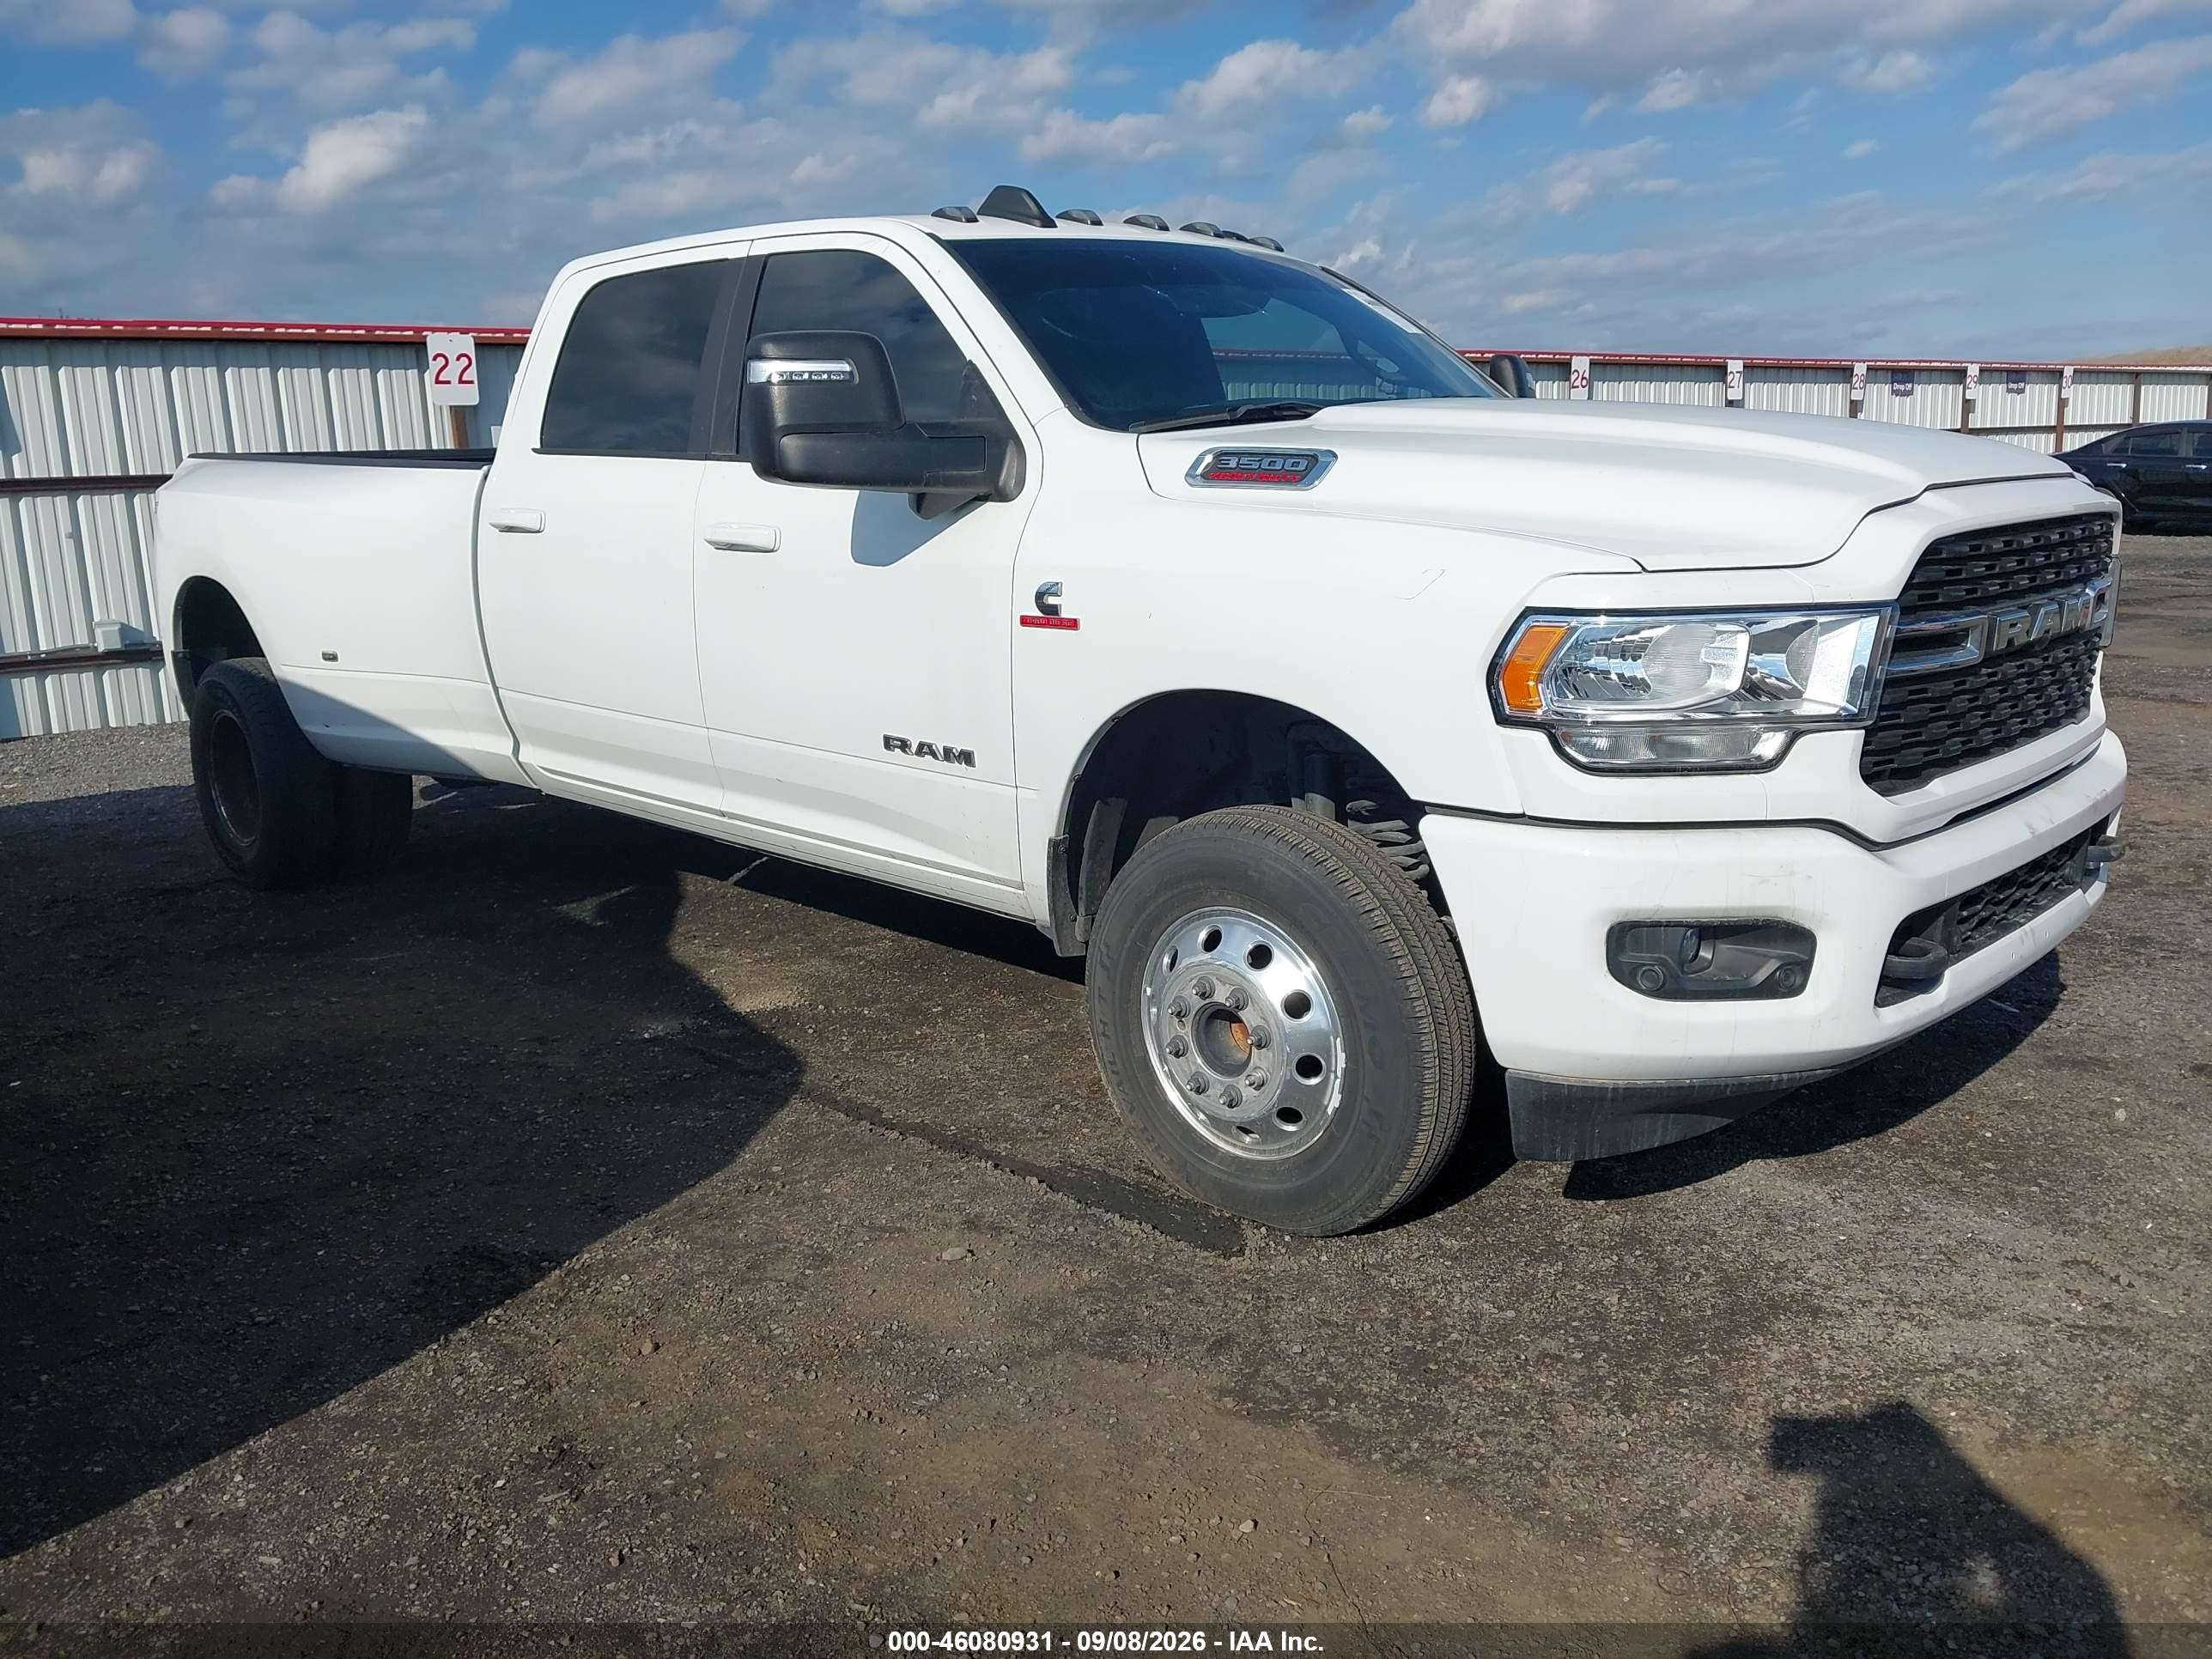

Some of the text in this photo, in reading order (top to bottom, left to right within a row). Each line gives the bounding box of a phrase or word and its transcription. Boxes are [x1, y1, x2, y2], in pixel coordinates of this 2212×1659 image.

[432, 352, 475, 385] 22
[1571, 369, 1588, 389] 26
[1728, 371, 1742, 389] 27
[1852, 374, 1865, 390] 28
[1893, 383, 1905, 392] Drop
[1966, 374, 1978, 390] 29
[2062, 374, 2073, 389] 30
[1217, 456, 1308, 471] 3500
[1992, 596, 2092, 651] RAM
[883, 733, 976, 769] RAM
